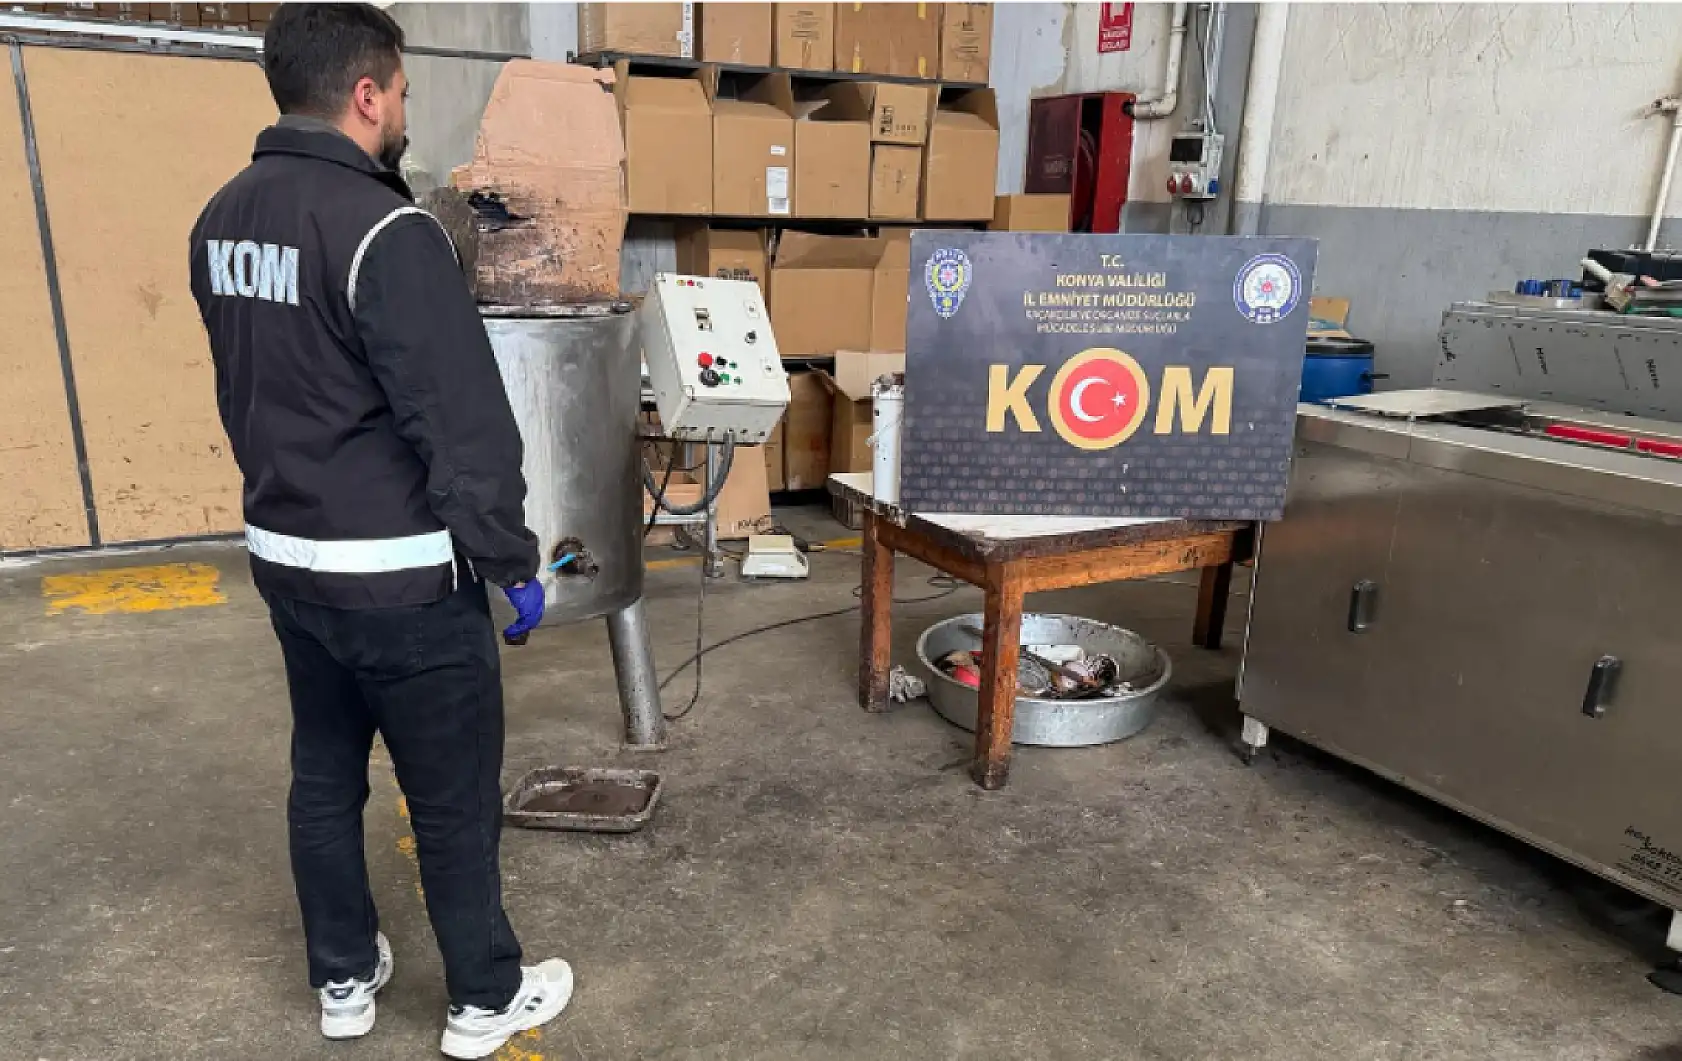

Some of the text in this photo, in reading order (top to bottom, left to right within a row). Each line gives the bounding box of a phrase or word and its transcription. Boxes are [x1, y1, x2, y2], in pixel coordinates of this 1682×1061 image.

[1101, 254, 1125, 268] T.C.
[206, 239, 300, 306] KOM
[1056, 272, 1166, 288] KONYA VALİLİĞİ
[1024, 290, 1036, 307] İL
[1039, 290, 1100, 307] EMNİYET
